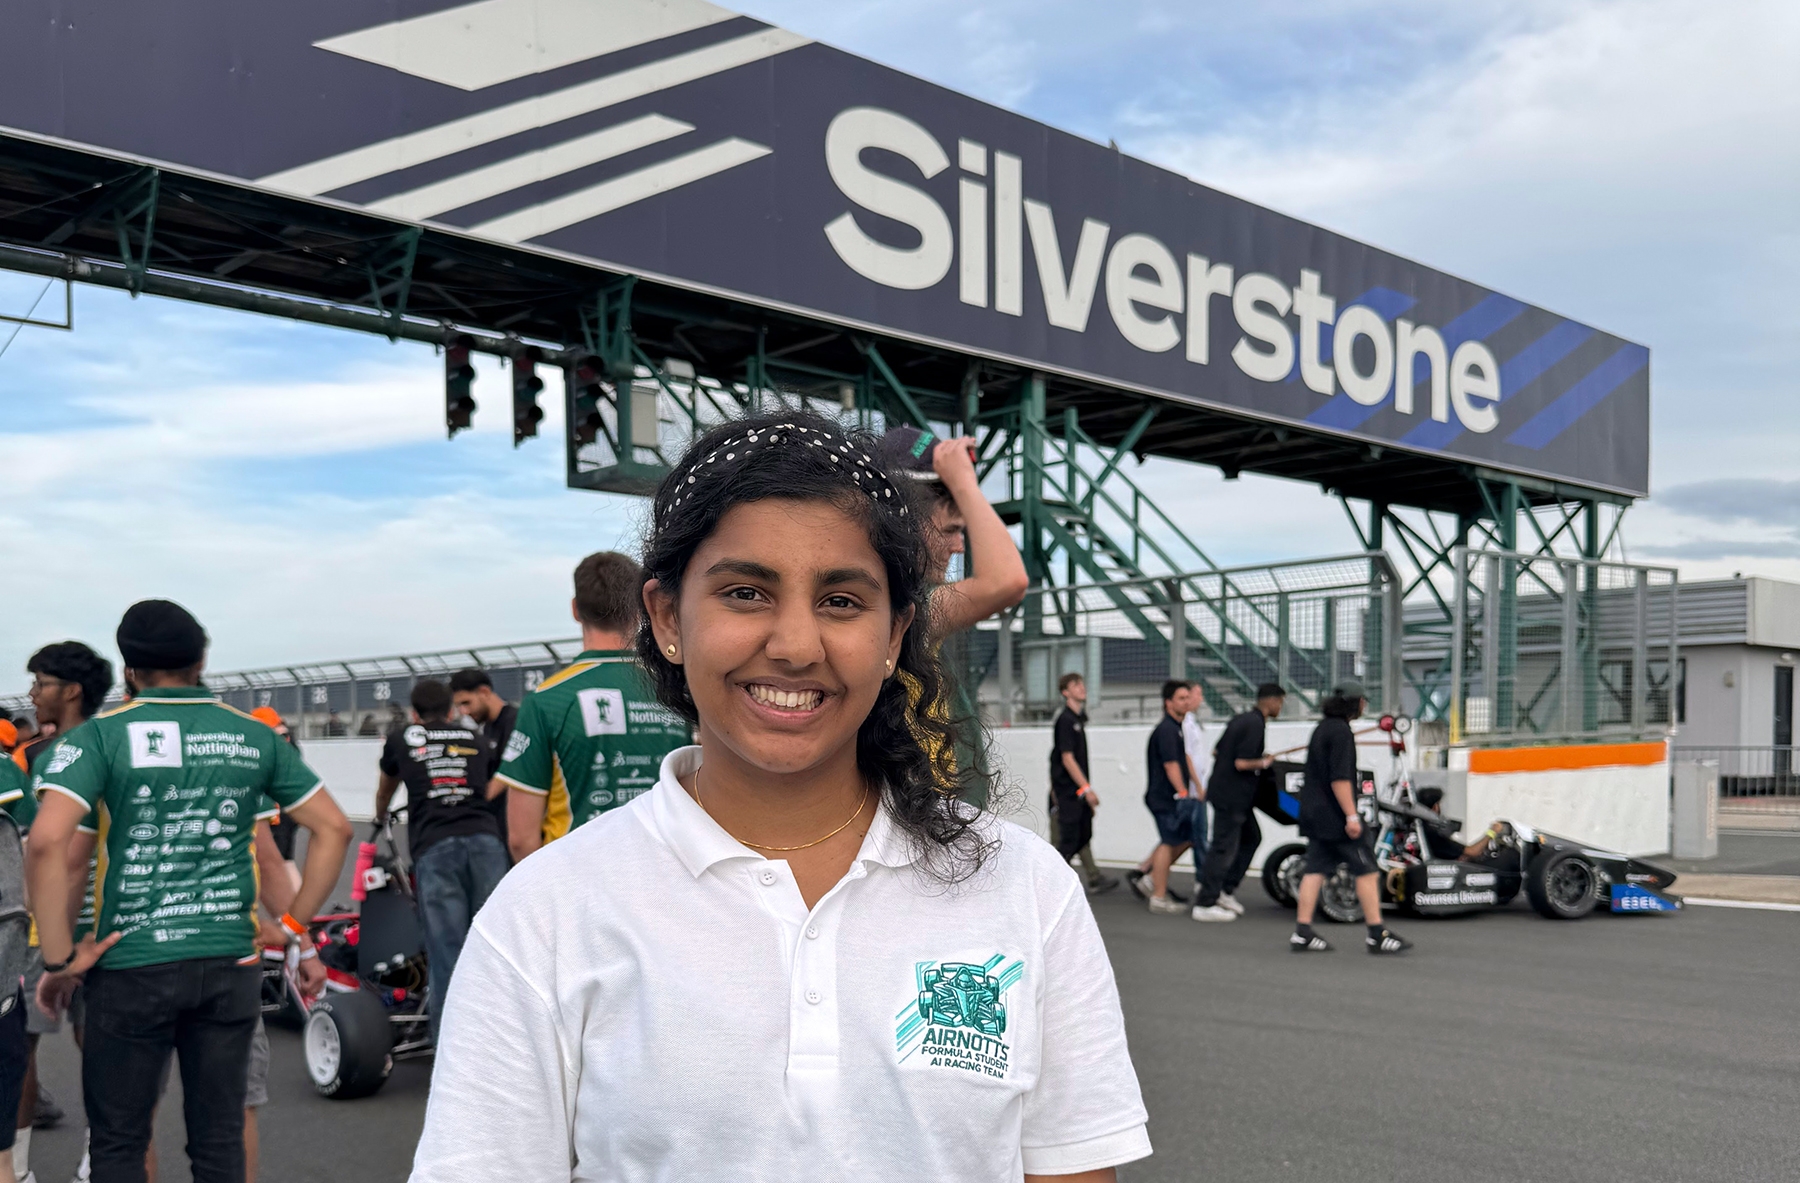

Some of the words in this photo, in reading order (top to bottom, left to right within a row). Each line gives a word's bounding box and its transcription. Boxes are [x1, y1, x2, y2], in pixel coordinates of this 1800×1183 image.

[823, 106, 1500, 433] Silverstone
[187, 742, 260, 759] Nottingham
[1415, 892, 1460, 905] Swansea
[922, 1027, 1010, 1062] AIRNOTTS
[921, 1046, 973, 1060] FORMULA
[975, 1053, 1009, 1072] STUDENT
[930, 1057, 942, 1067] AI
[944, 1058, 982, 1073] RACING
[983, 1065, 1004, 1079] TEAM
